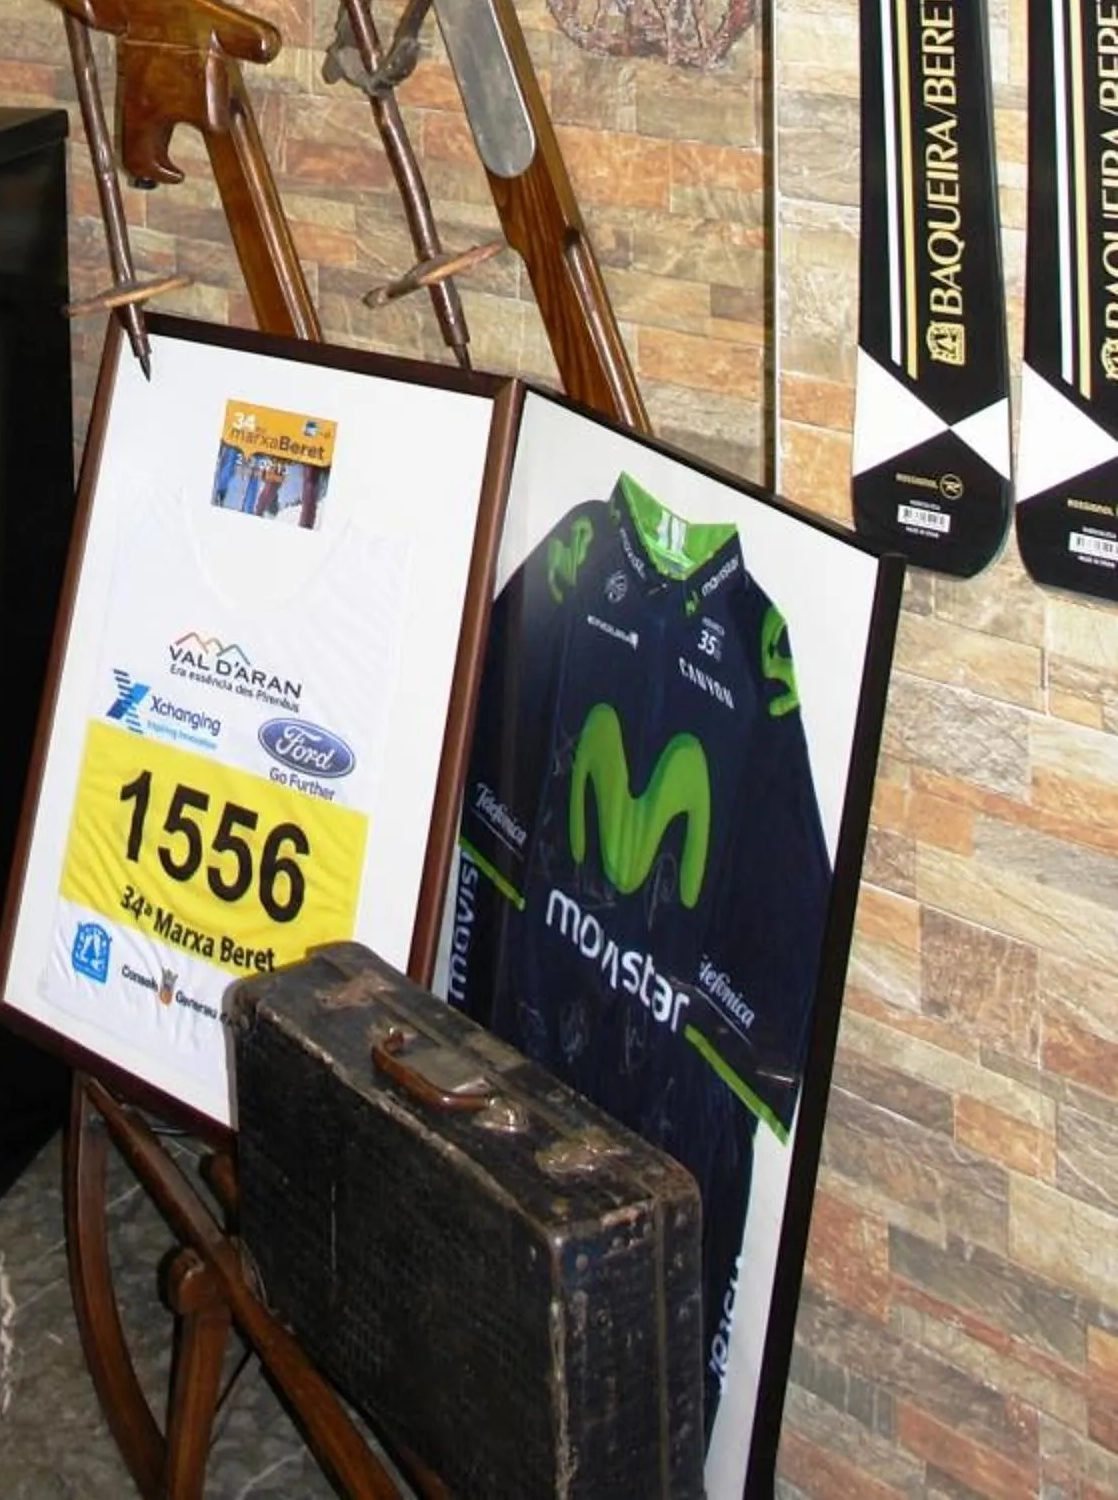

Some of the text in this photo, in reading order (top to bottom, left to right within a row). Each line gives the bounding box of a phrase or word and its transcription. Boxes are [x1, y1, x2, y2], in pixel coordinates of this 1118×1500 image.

[697, 629, 716, 655] 35
[169, 645, 303, 700] VAL D'ARAN
[678, 657, 735, 710] CANYON
[148, 695, 222, 737] Xchanging
[275, 725, 336, 770] Ford
[269, 766, 336, 801] Go Further
[119, 769, 311, 924] 1556
[153, 908, 215, 958] Marxa
[219, 936, 276, 973] Beret
